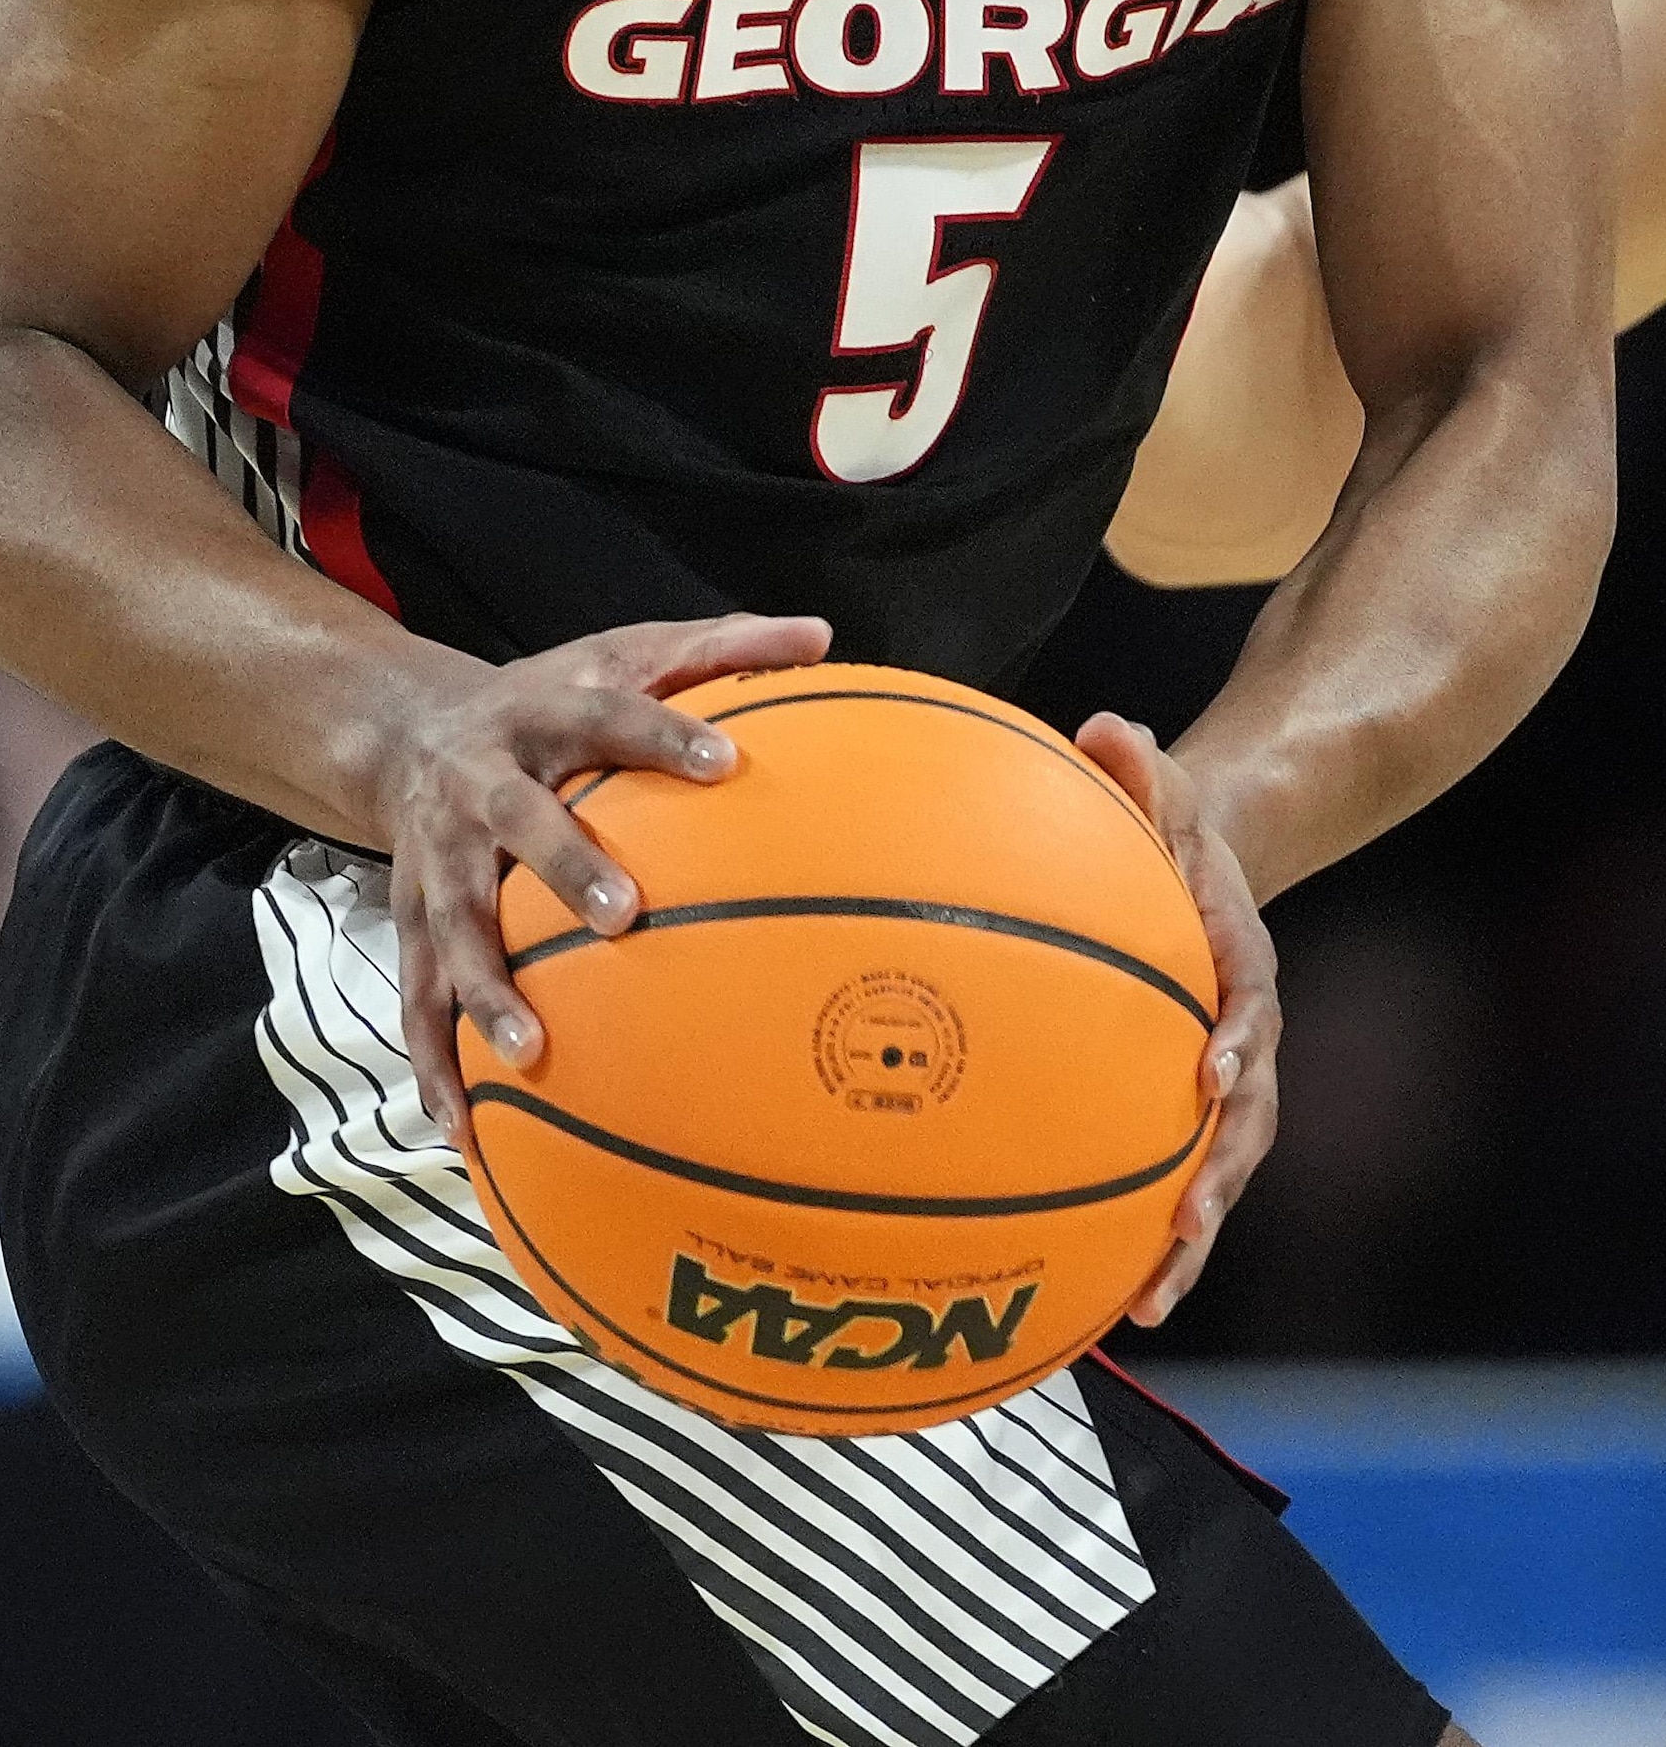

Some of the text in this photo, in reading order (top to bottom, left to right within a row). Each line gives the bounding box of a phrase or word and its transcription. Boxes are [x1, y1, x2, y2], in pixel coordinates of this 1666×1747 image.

[808, 134, 1064, 483] 5
[666, 1251, 1041, 1370] NCAA
[683, 1230, 1045, 1292] OFFICIAL GAME BALL
